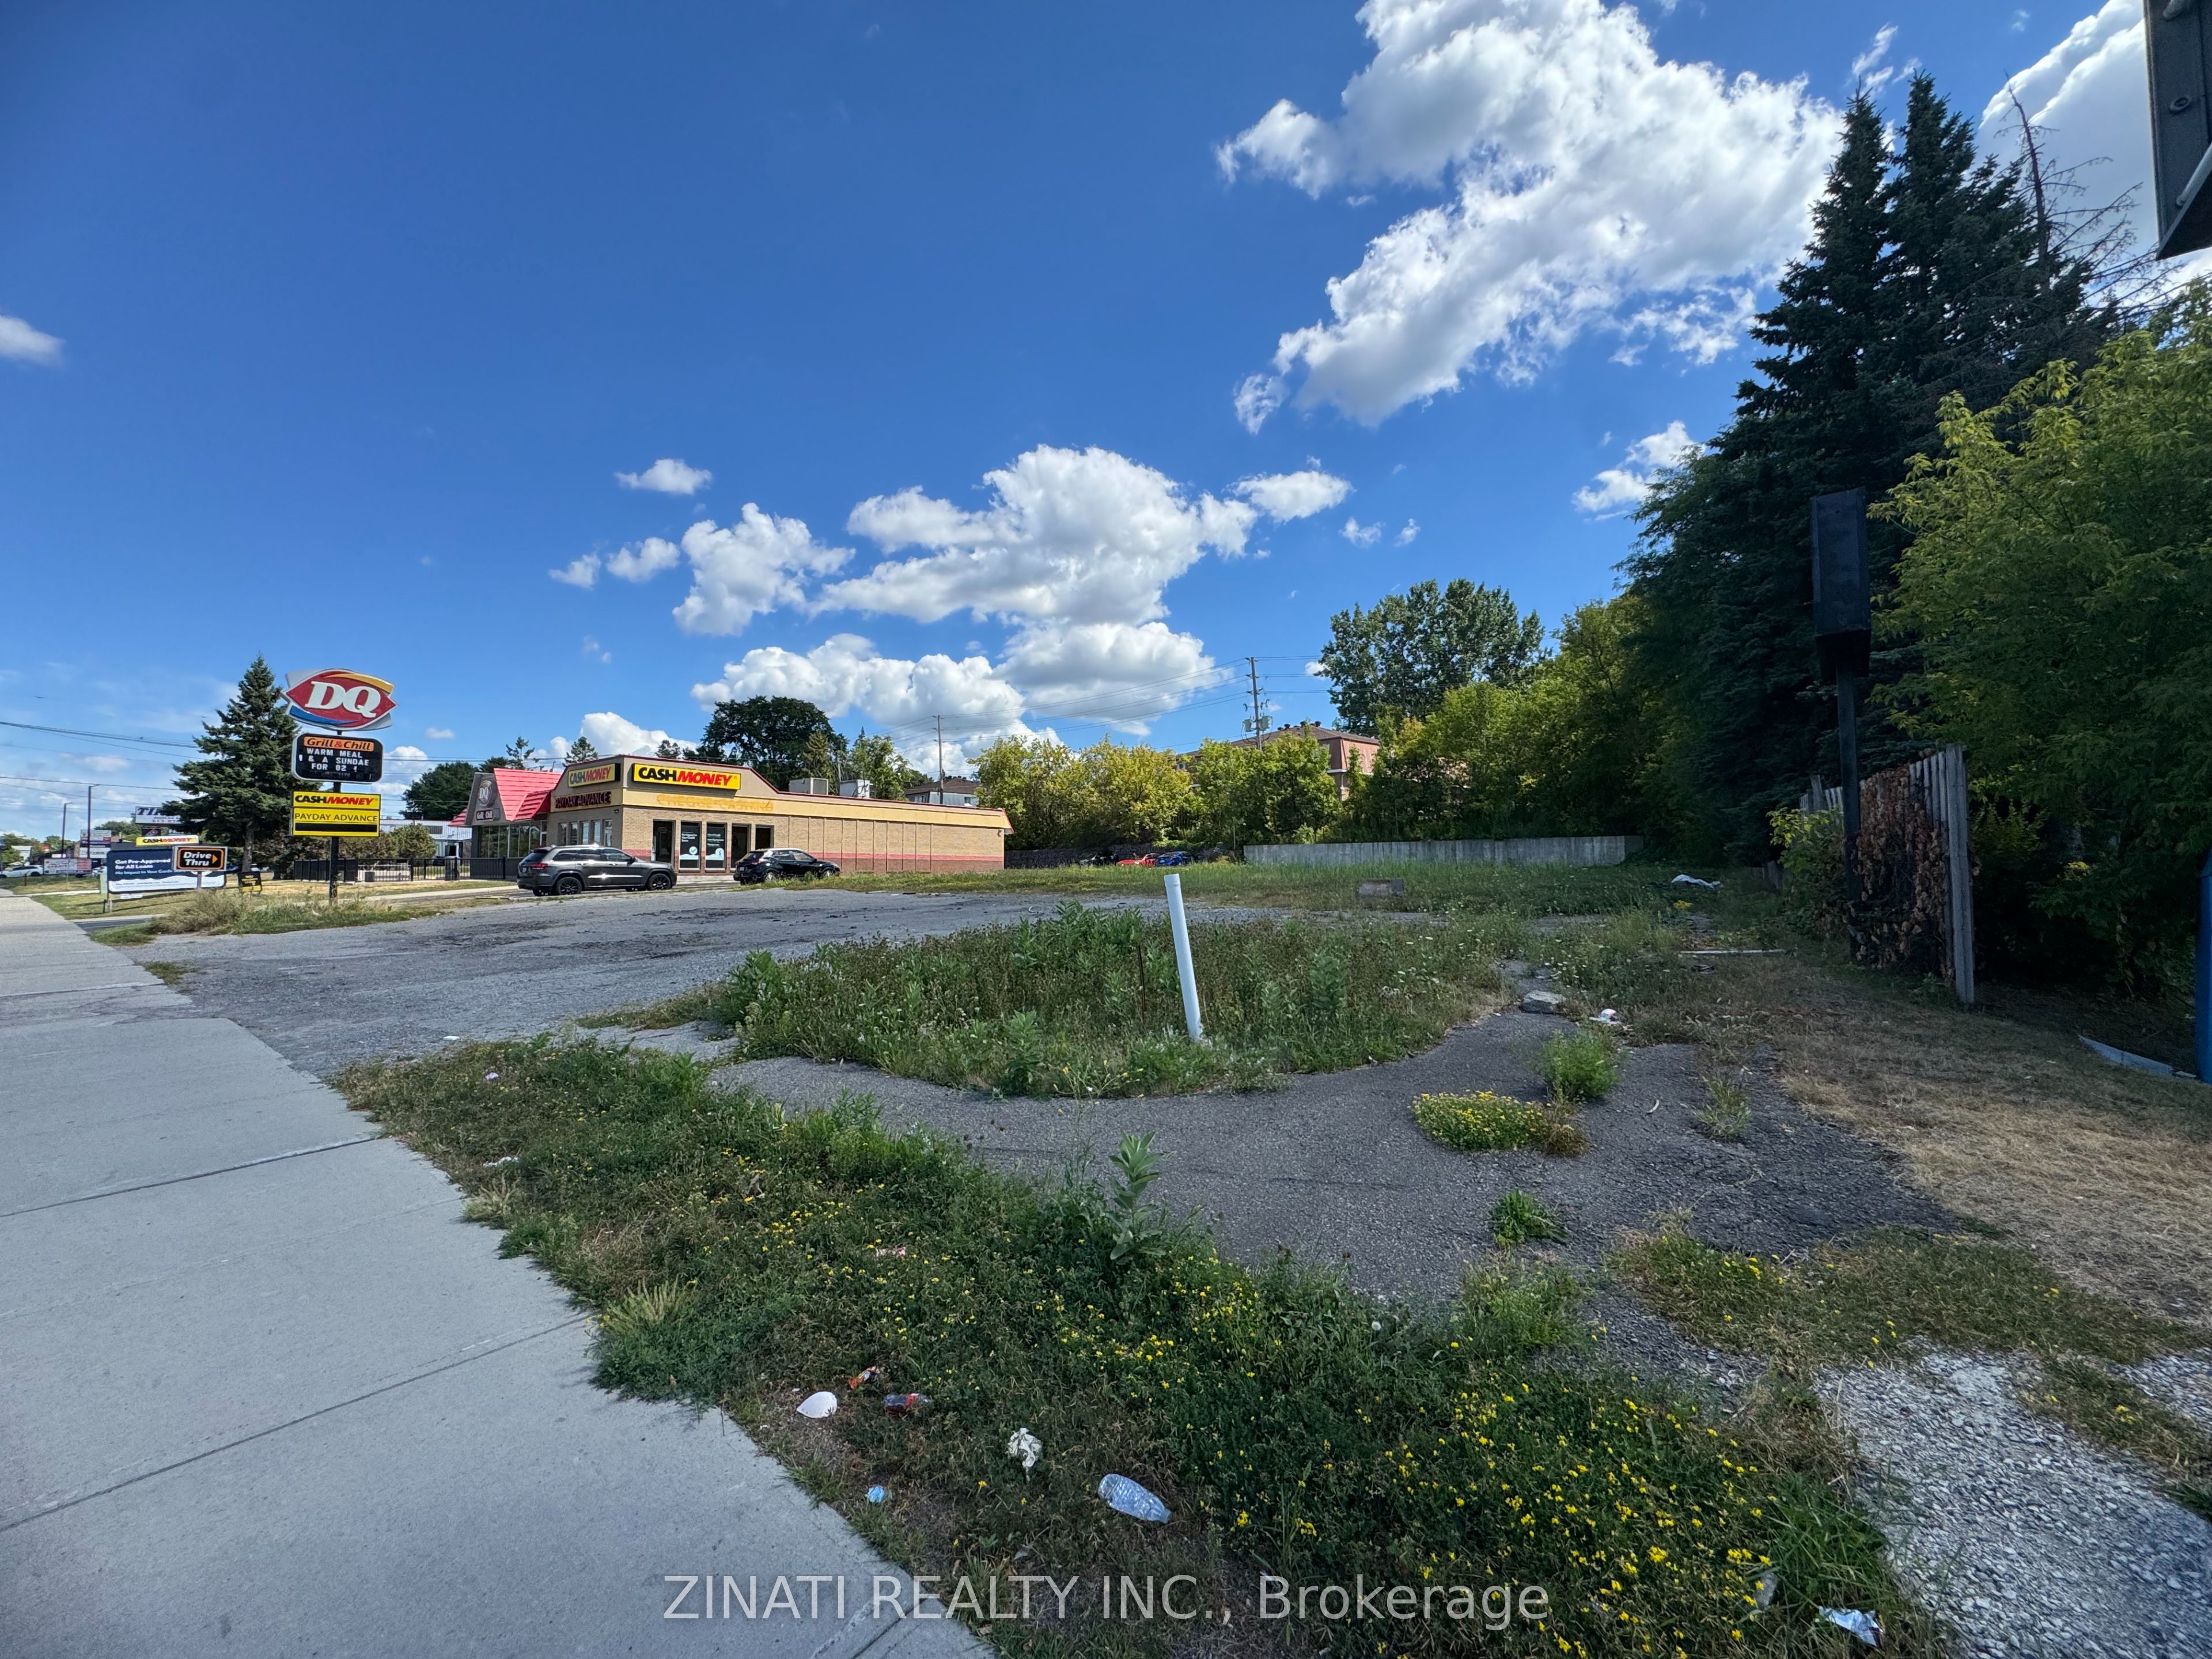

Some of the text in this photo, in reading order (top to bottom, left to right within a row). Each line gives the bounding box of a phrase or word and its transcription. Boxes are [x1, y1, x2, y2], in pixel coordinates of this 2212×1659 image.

[305, 681, 381, 718] DQ
[306, 748, 334, 756] WARM
[336, 757, 369, 766] SUNDAE
[555, 792, 609, 808] PAYDAY ADVANCE
[333, 814, 378, 822] ADVANCE
